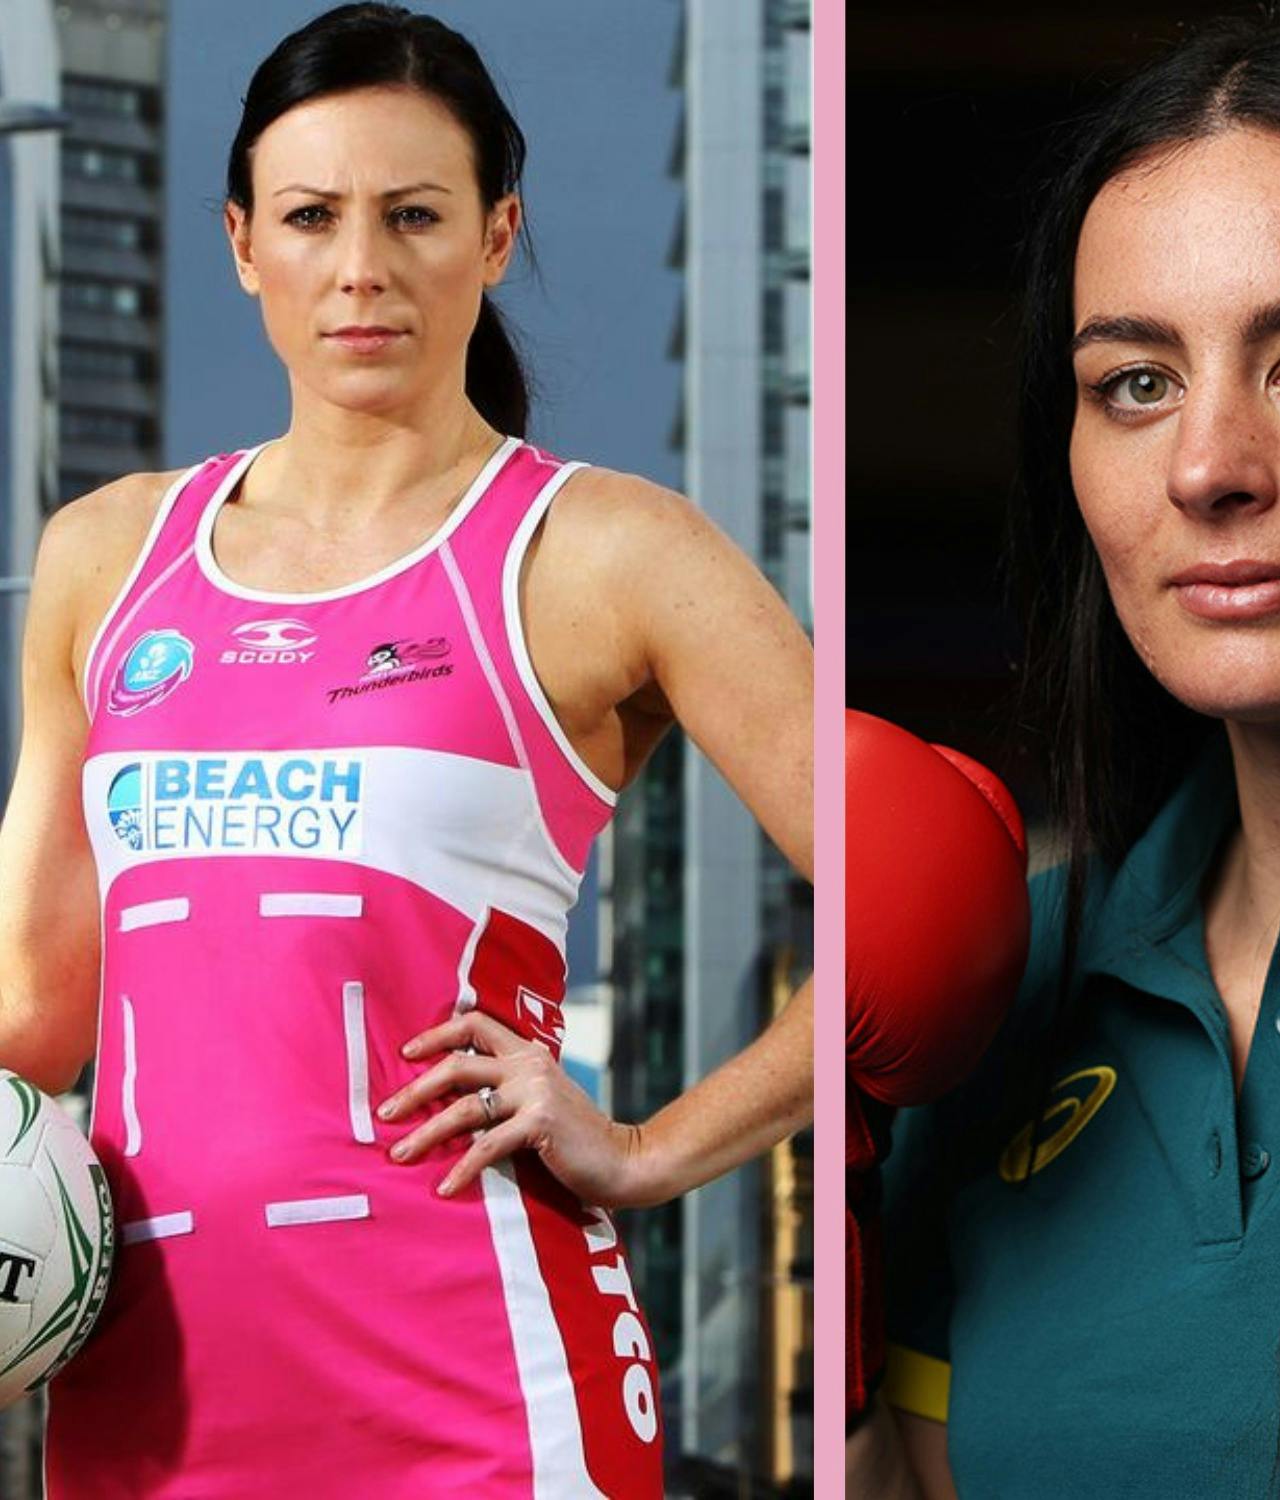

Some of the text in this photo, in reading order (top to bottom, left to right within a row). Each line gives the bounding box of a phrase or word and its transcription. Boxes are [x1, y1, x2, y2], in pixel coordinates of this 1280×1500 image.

[220, 651, 315, 664] SCODY
[327, 664, 454, 703] Thunderbirds
[155, 759, 361, 803] BEACH
[154, 805, 358, 851] ENERGY
